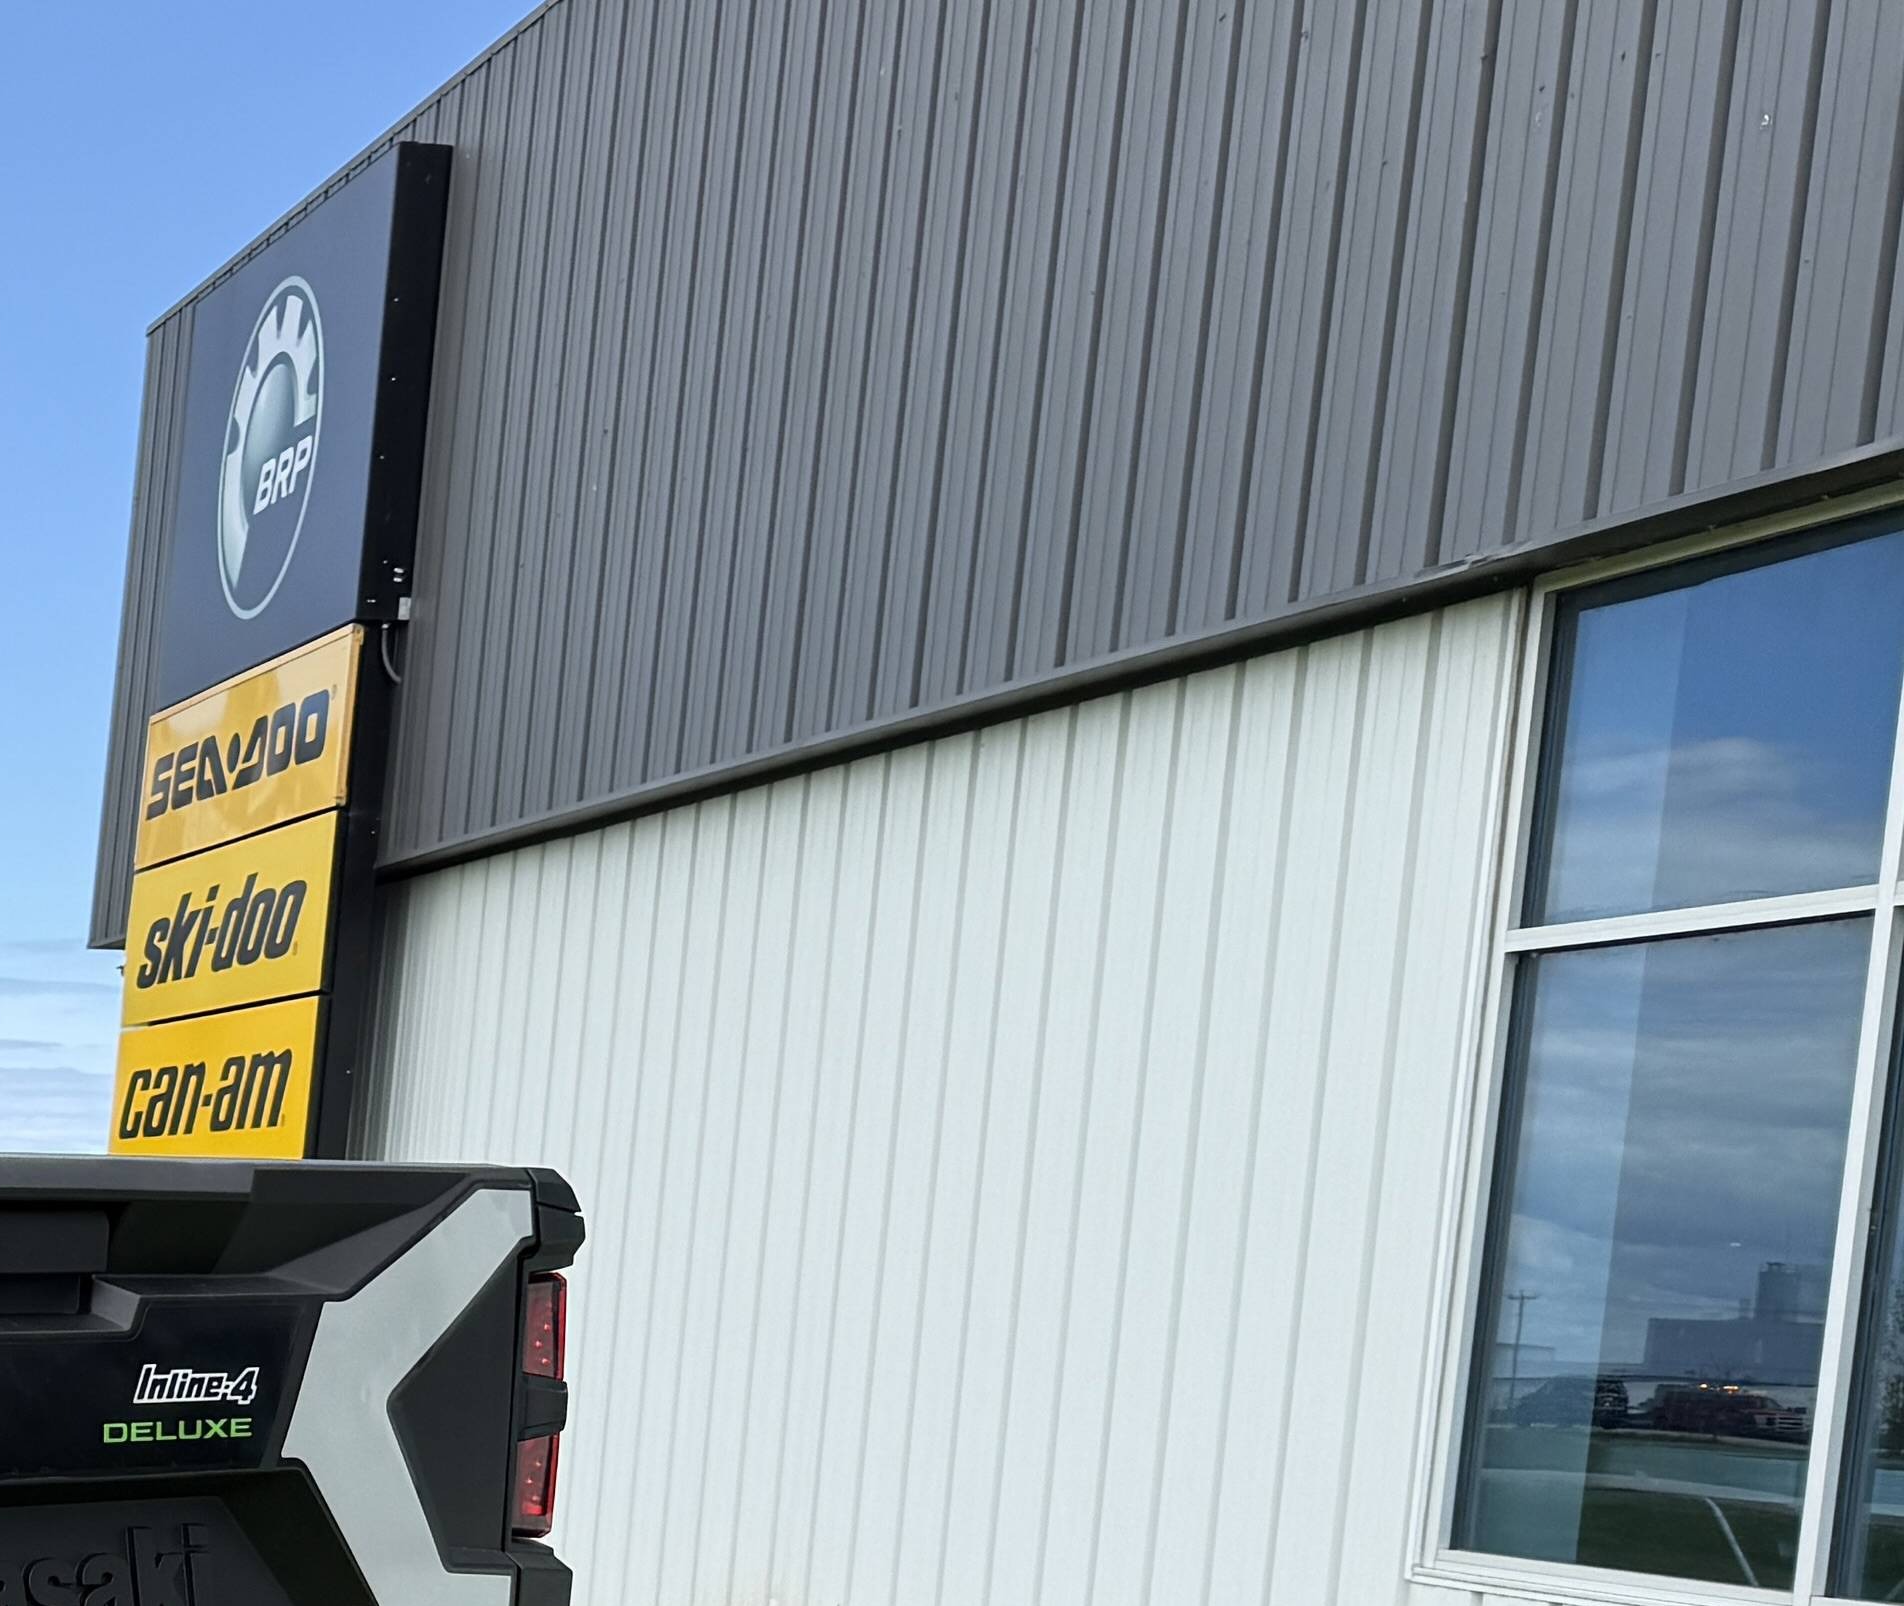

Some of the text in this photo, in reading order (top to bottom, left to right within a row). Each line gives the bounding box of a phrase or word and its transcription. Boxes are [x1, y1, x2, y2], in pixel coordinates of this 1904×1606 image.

[253, 434, 313, 516] BRP
[136, 871, 308, 990] ski-doo
[118, 1047, 293, 1141] can-am
[133, 1363, 260, 1405] Inline-4
[102, 1417, 253, 1444] DELUXE
